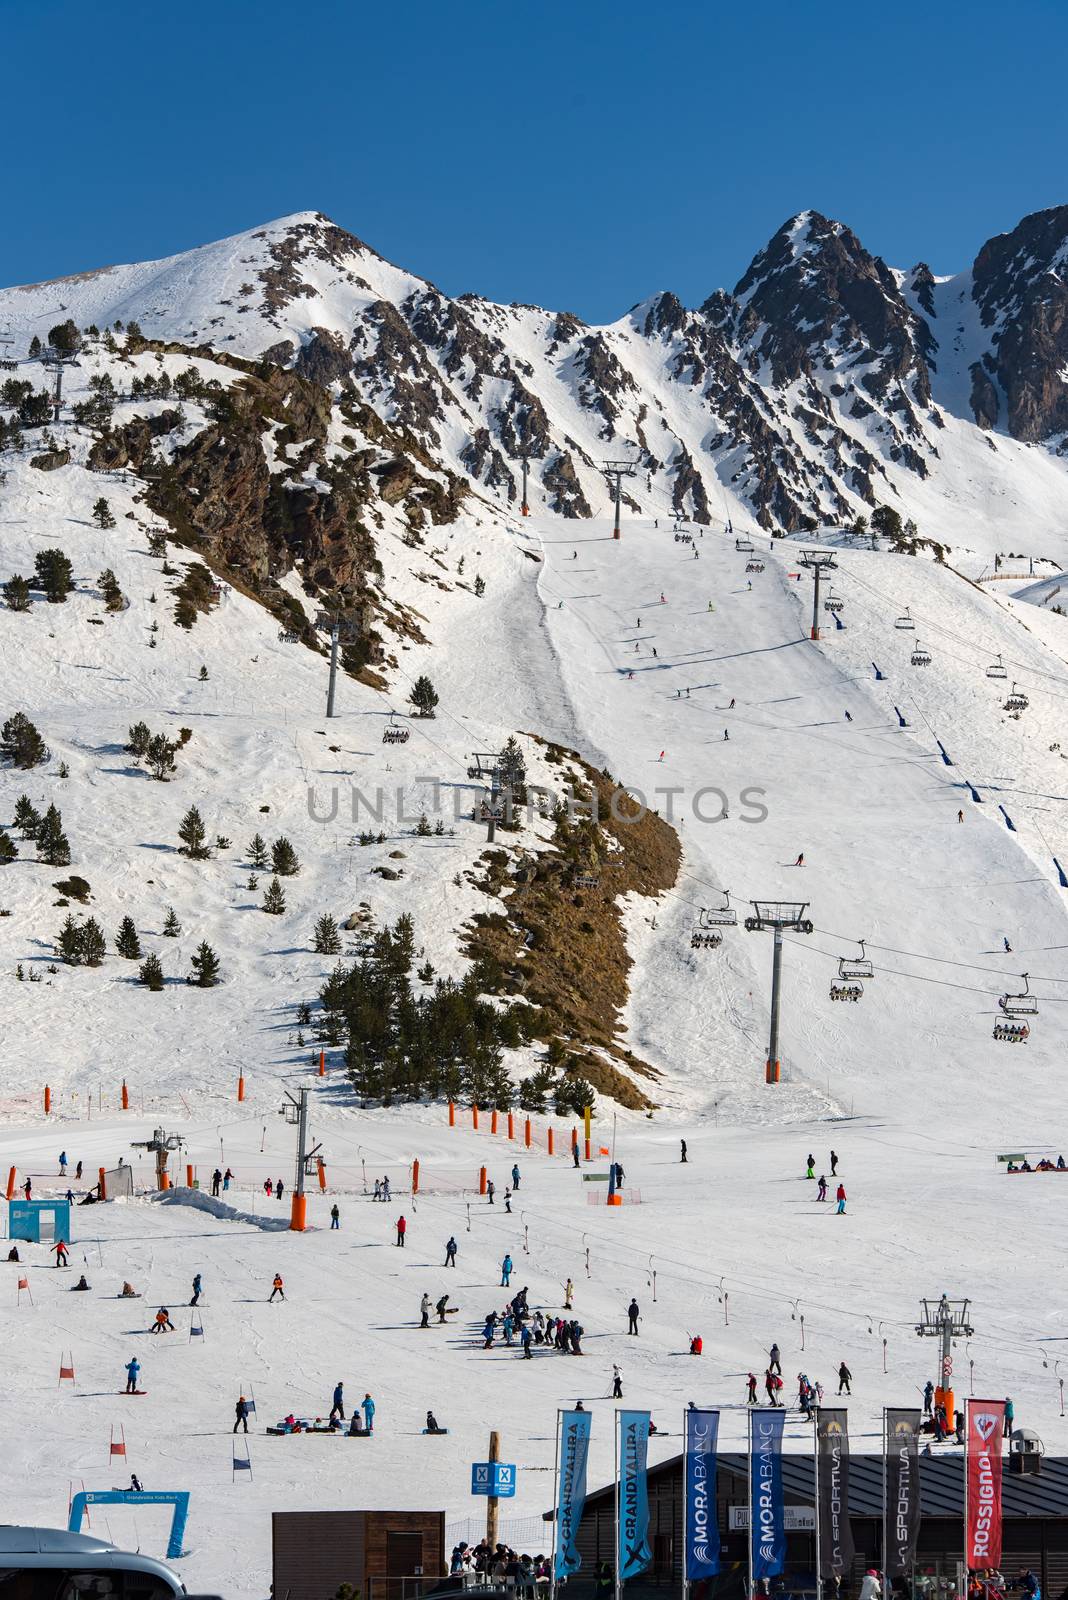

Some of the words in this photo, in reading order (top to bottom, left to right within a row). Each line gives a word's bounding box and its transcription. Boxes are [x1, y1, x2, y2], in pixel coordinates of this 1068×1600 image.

[562, 1423, 578, 1540] GRANDVALIRA
[625, 1423, 638, 1540] GRANDVALIRA
[694, 1423, 708, 1543] MORABANC
[759, 1423, 775, 1542] MORABANC
[830, 1446, 841, 1542] SPORTIVA
[897, 1446, 911, 1542] SPORTIVA
